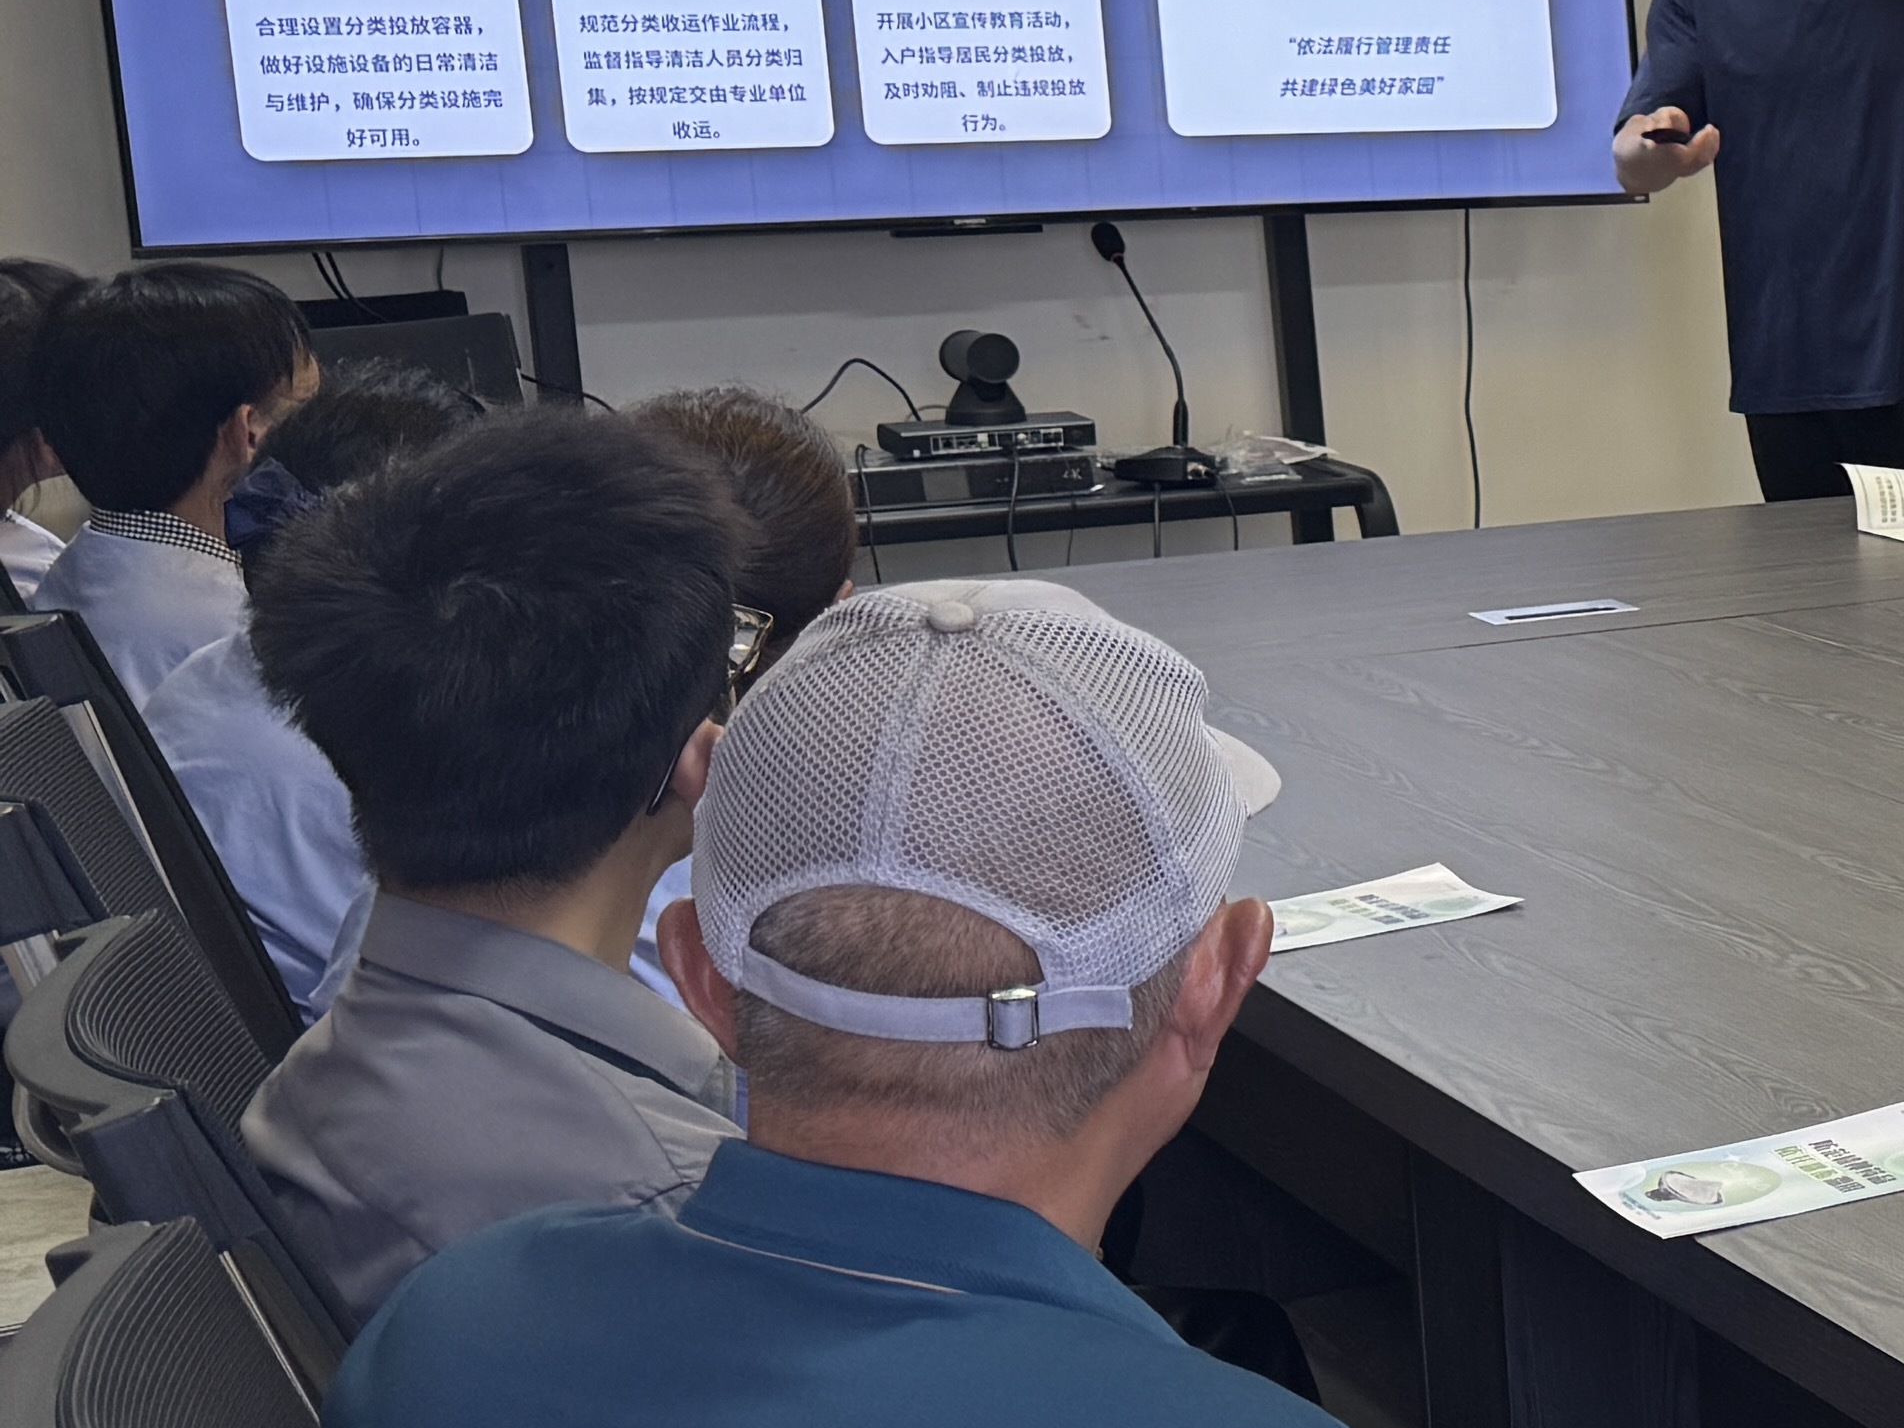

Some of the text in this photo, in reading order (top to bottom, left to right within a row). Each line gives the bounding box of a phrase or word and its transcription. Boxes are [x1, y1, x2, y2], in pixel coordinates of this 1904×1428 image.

[255, 14, 486, 38] 合理设置分类投放容器，
[579, 13, 790, 34] 规范分类收运作业流程，
[876, 10, 1071, 31] 开展小区宣传教育活动，
[260, 52, 499, 76] 做好设施设备的日常清洁
[583, 48, 804, 70] 监督指导清洁人员分类归
[881, 45, 1075, 66] 入户指导居民分类投放，
[587, 85, 808, 108] 集，按规定交由专业单位
[884, 77, 1086, 100] 及时劝阻、制止违规投放
[265, 89, 504, 114] 与维护，确保分类设施完
[672, 121, 721, 141] 收运。
[962, 113, 1009, 133] 行为。
[346, 128, 423, 149] 好可用。
